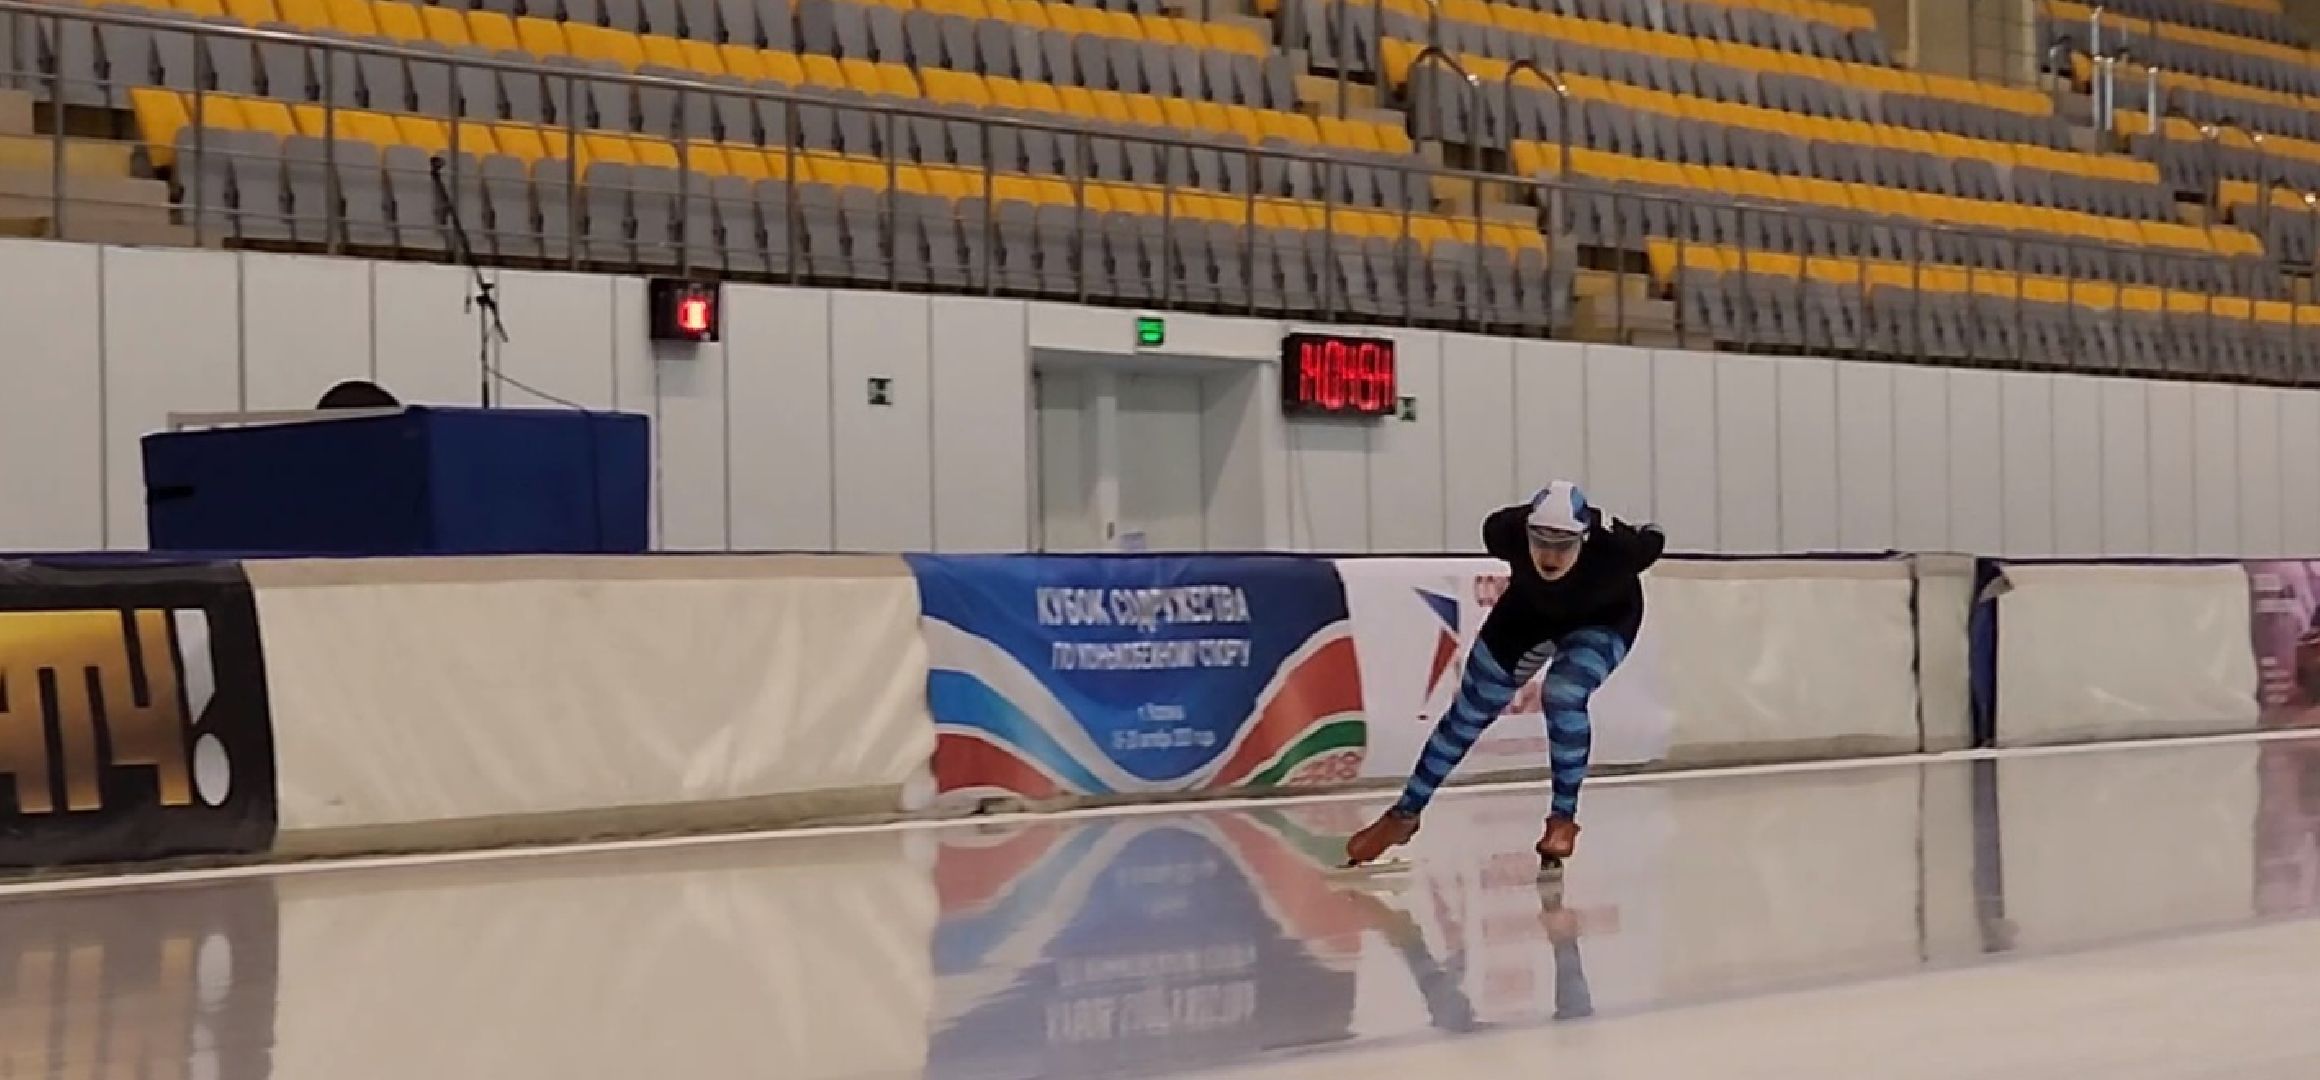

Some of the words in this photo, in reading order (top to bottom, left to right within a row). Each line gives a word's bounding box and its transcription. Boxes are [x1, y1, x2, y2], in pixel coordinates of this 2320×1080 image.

[1036, 587, 1112, 625] КУБОК
[1109, 584, 1251, 633] СОДРУЖЕСТВА
[1052, 641, 1077, 670] ПО
